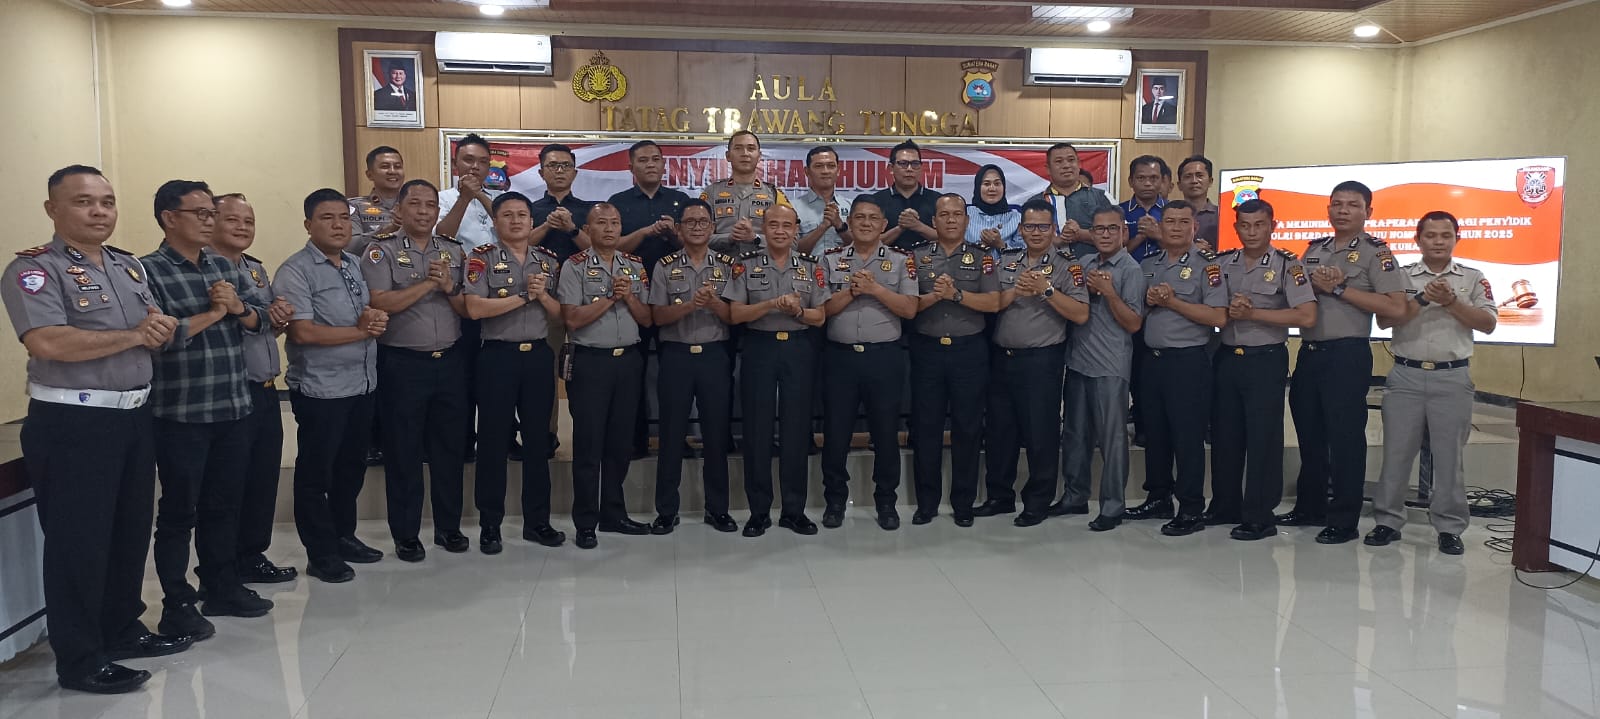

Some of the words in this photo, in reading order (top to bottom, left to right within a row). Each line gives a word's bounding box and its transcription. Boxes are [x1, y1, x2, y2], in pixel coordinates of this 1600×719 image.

[750, 74, 836, 101] AULA
[602, 105, 691, 132] TATAG
[702, 106, 846, 135] TRAWANG
[860, 110, 979, 136] TUNGGA
[835, 160, 943, 188] HUKM
[1270, 232, 1293, 241] OLRI
[1484, 229, 1514, 239] 2025
[1457, 217, 1477, 226] AGI
